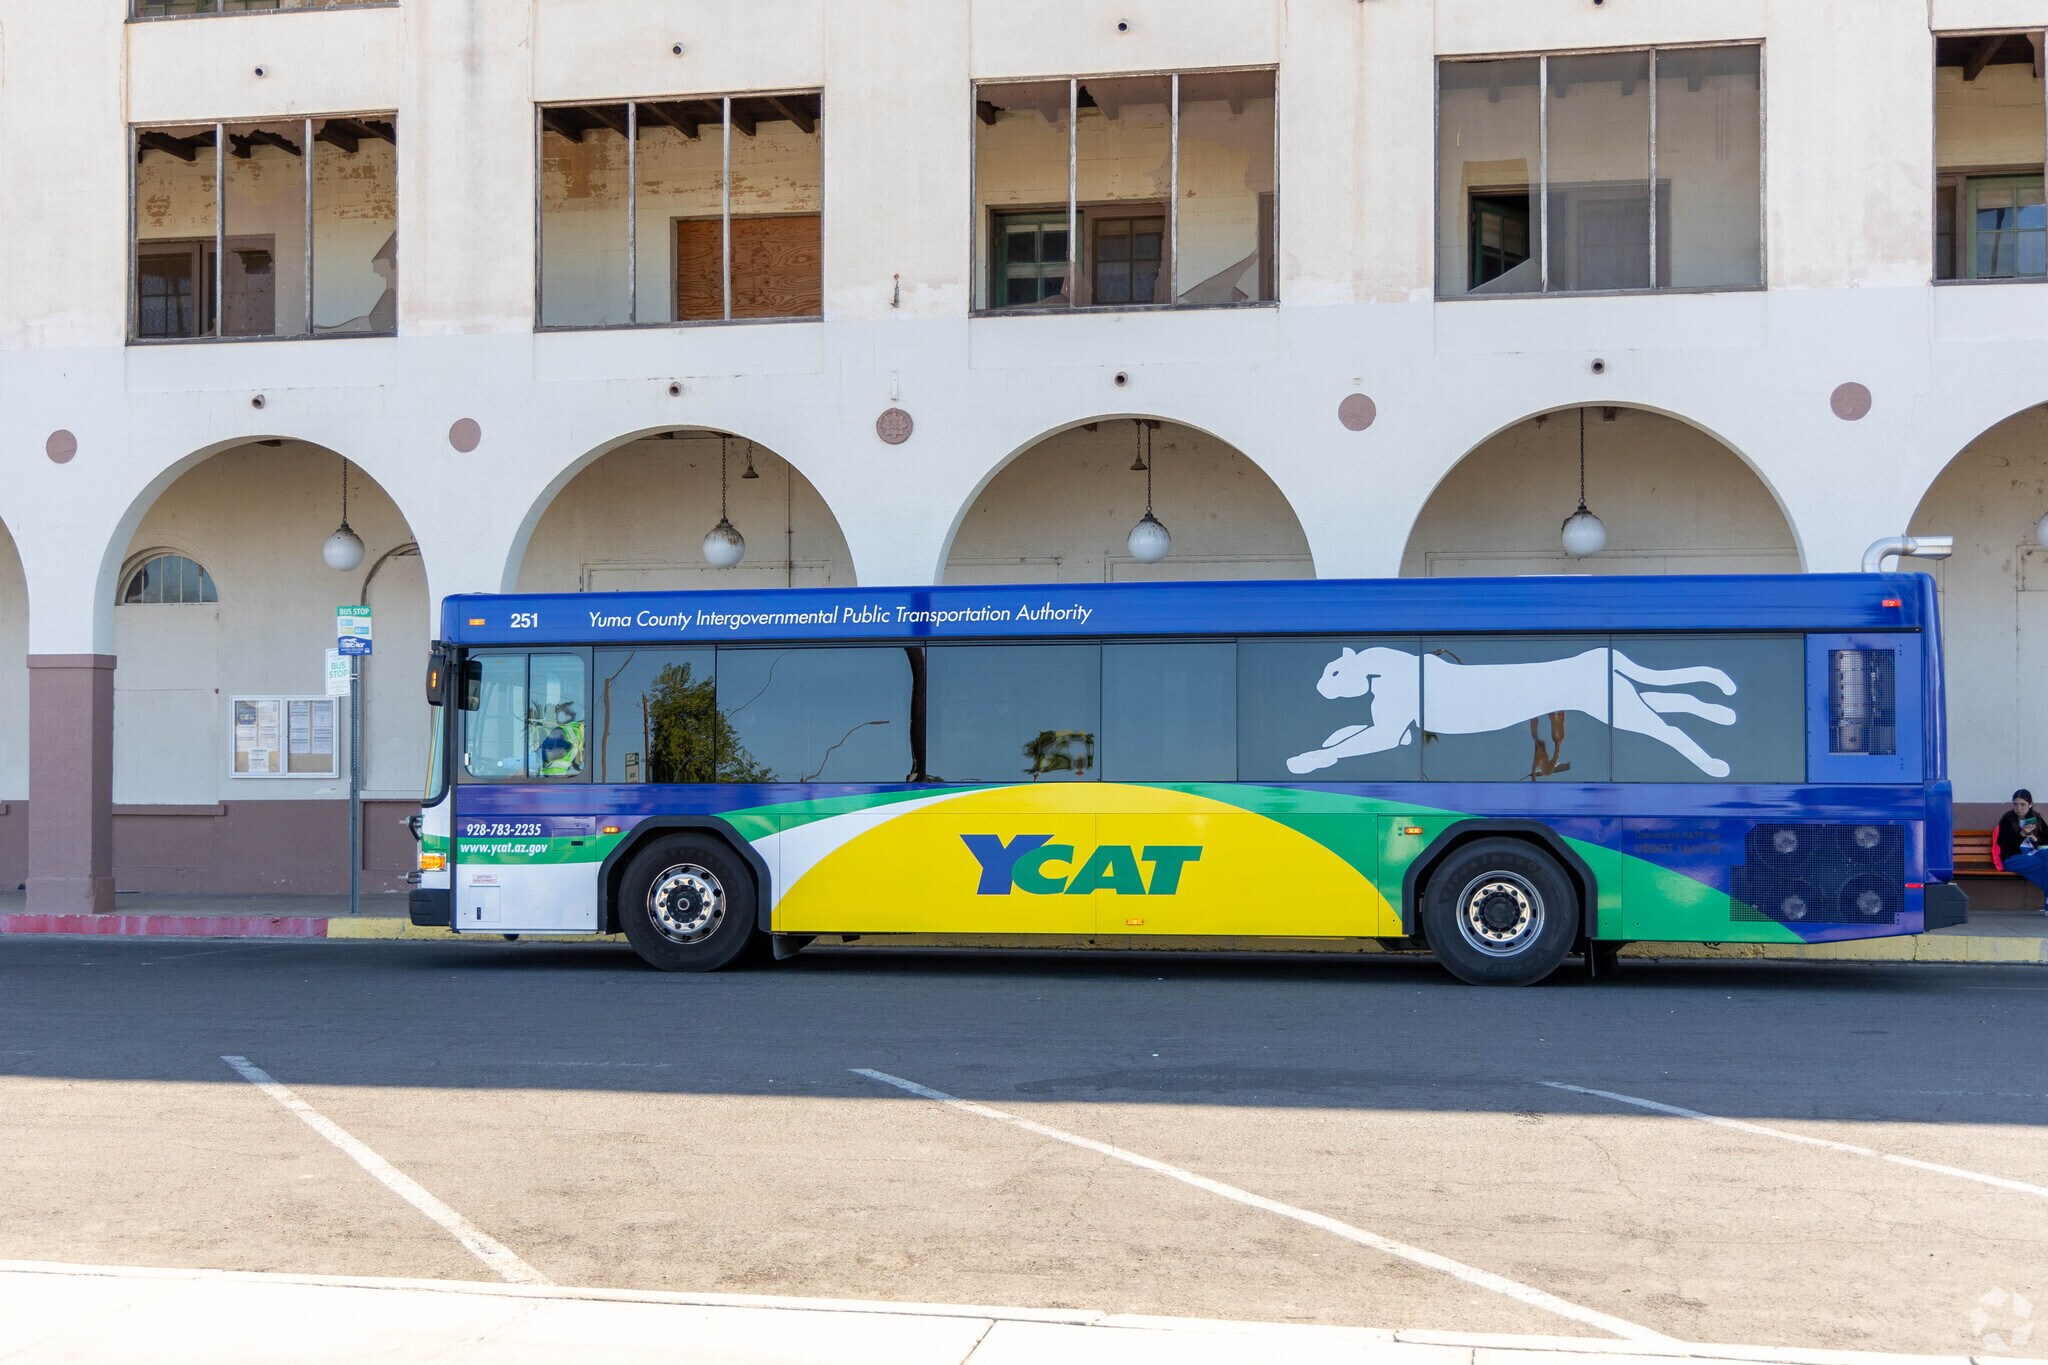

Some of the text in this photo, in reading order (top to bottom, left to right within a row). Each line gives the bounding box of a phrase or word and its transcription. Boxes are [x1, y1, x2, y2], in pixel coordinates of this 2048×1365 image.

[339, 608, 352, 616] BUS
[589, 601, 1093, 631] Yuma County Intergovernmental Public Transportation Authority
[510, 613, 538, 628] 251
[331, 661, 346, 670] BUS
[329, 670, 349, 678] STOP
[466, 823, 542, 836] 928-783-2235
[460, 842, 548, 856] www.ycat.az.gov
[959, 834, 1204, 895] YCAT
